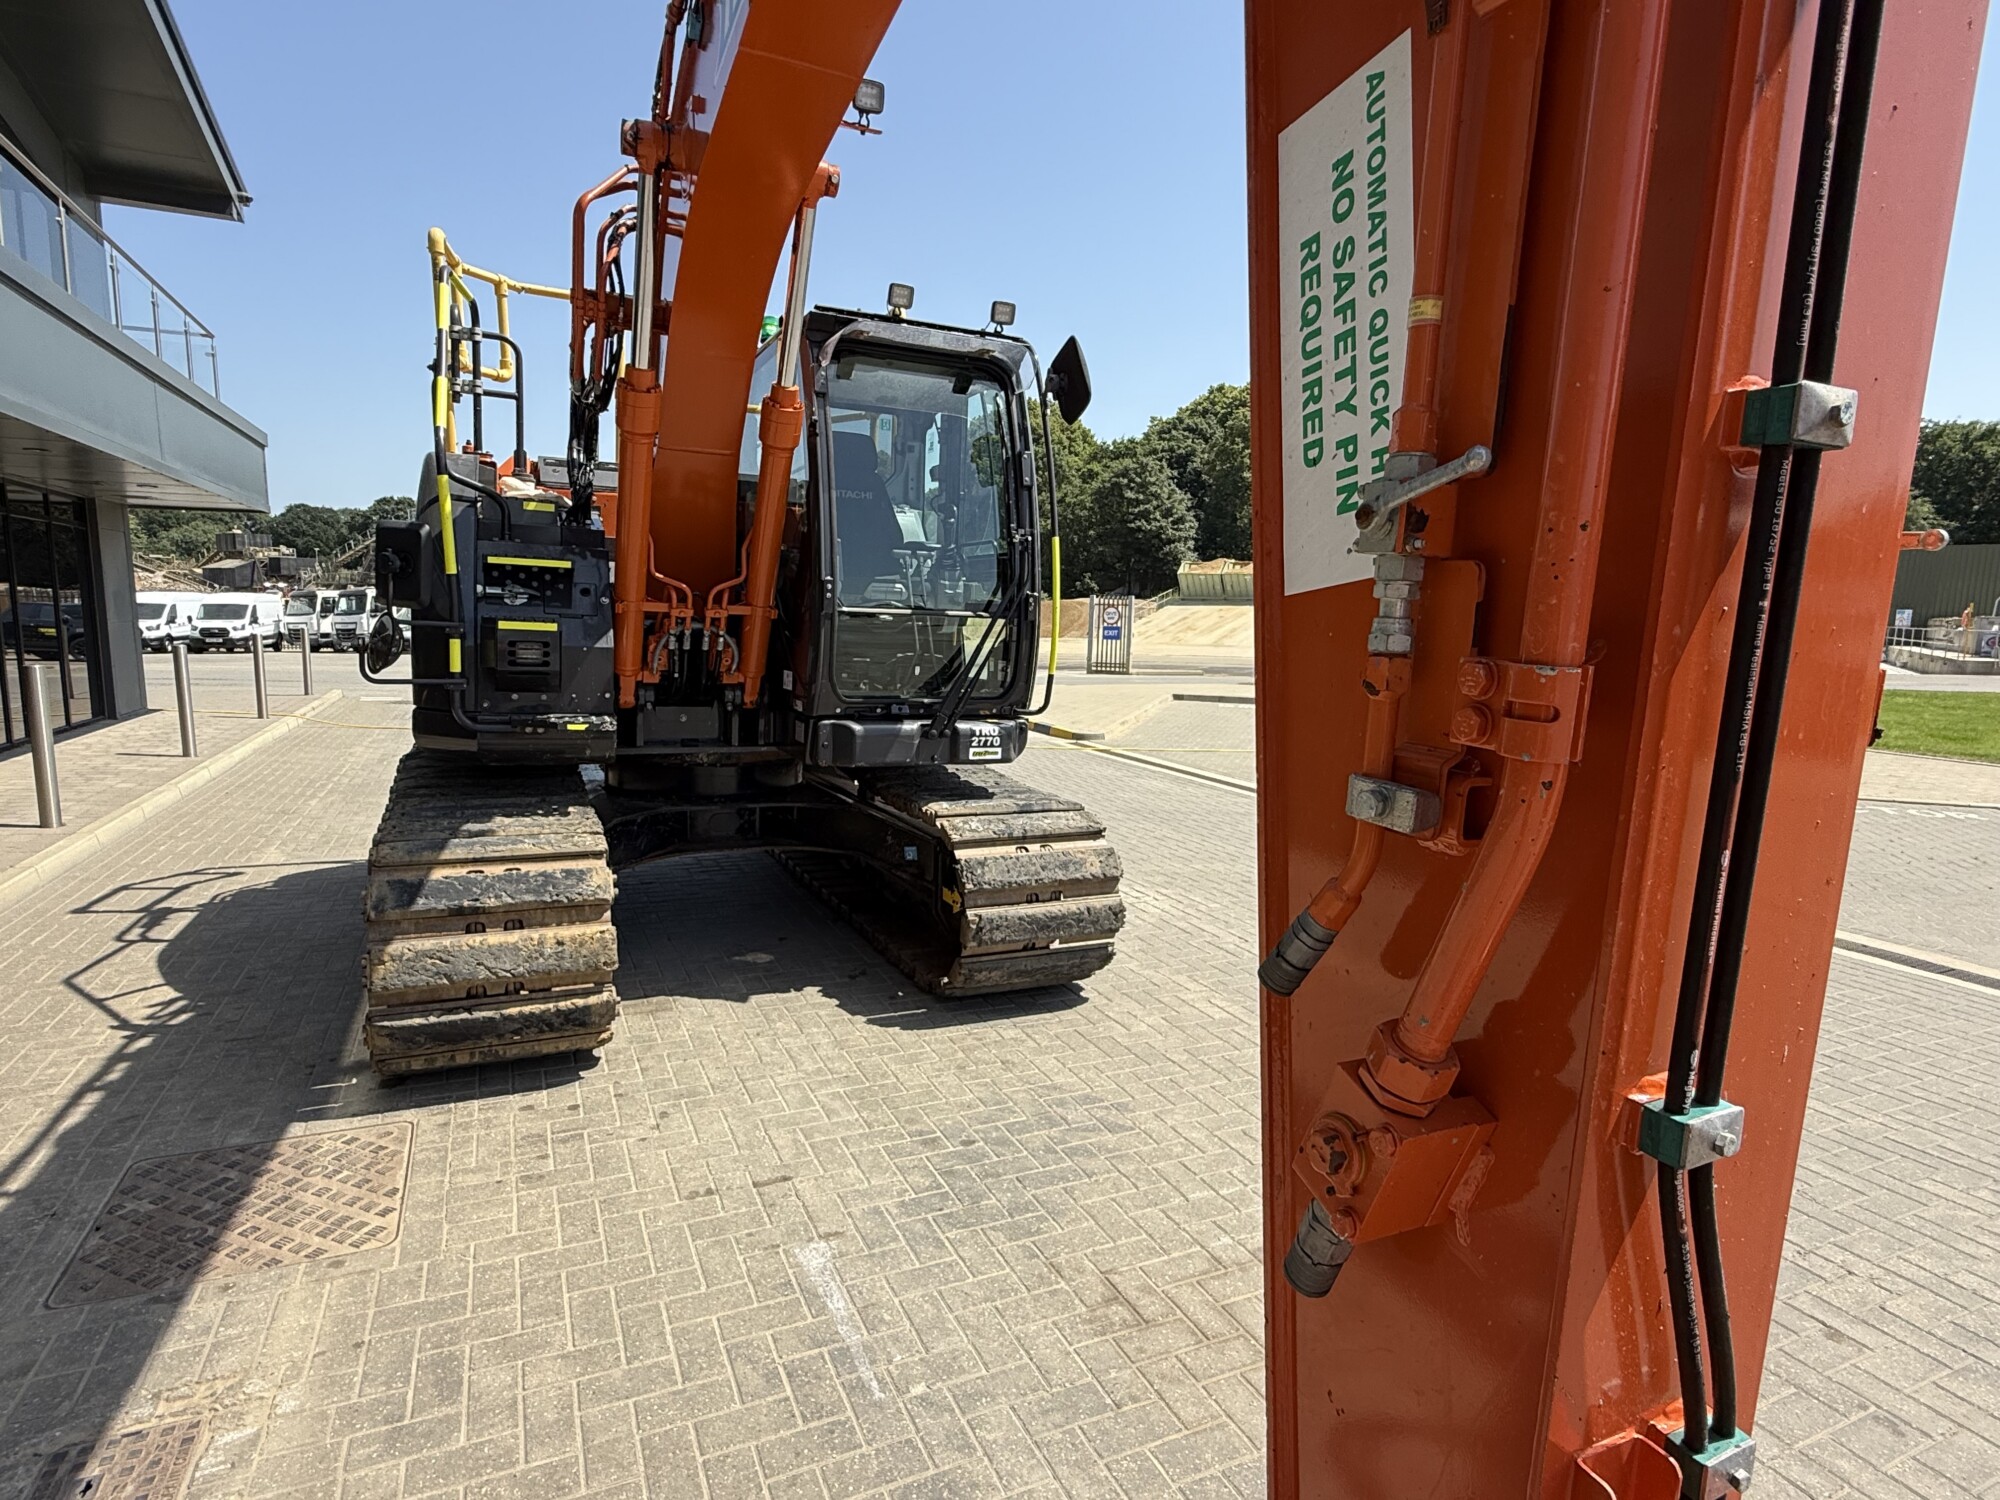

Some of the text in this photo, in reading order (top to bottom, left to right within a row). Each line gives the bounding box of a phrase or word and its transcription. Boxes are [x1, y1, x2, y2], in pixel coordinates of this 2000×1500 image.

[1366, 70, 1388, 299] AUTOMATIC
[1299, 231, 1324, 468] REQUIRED
[1332, 148, 1359, 517] NO SAFETY PIN
[1366, 315, 1390, 437] QUICK
[834, 489, 873, 500] ITACHI
[971, 736, 1001, 747] 2770
